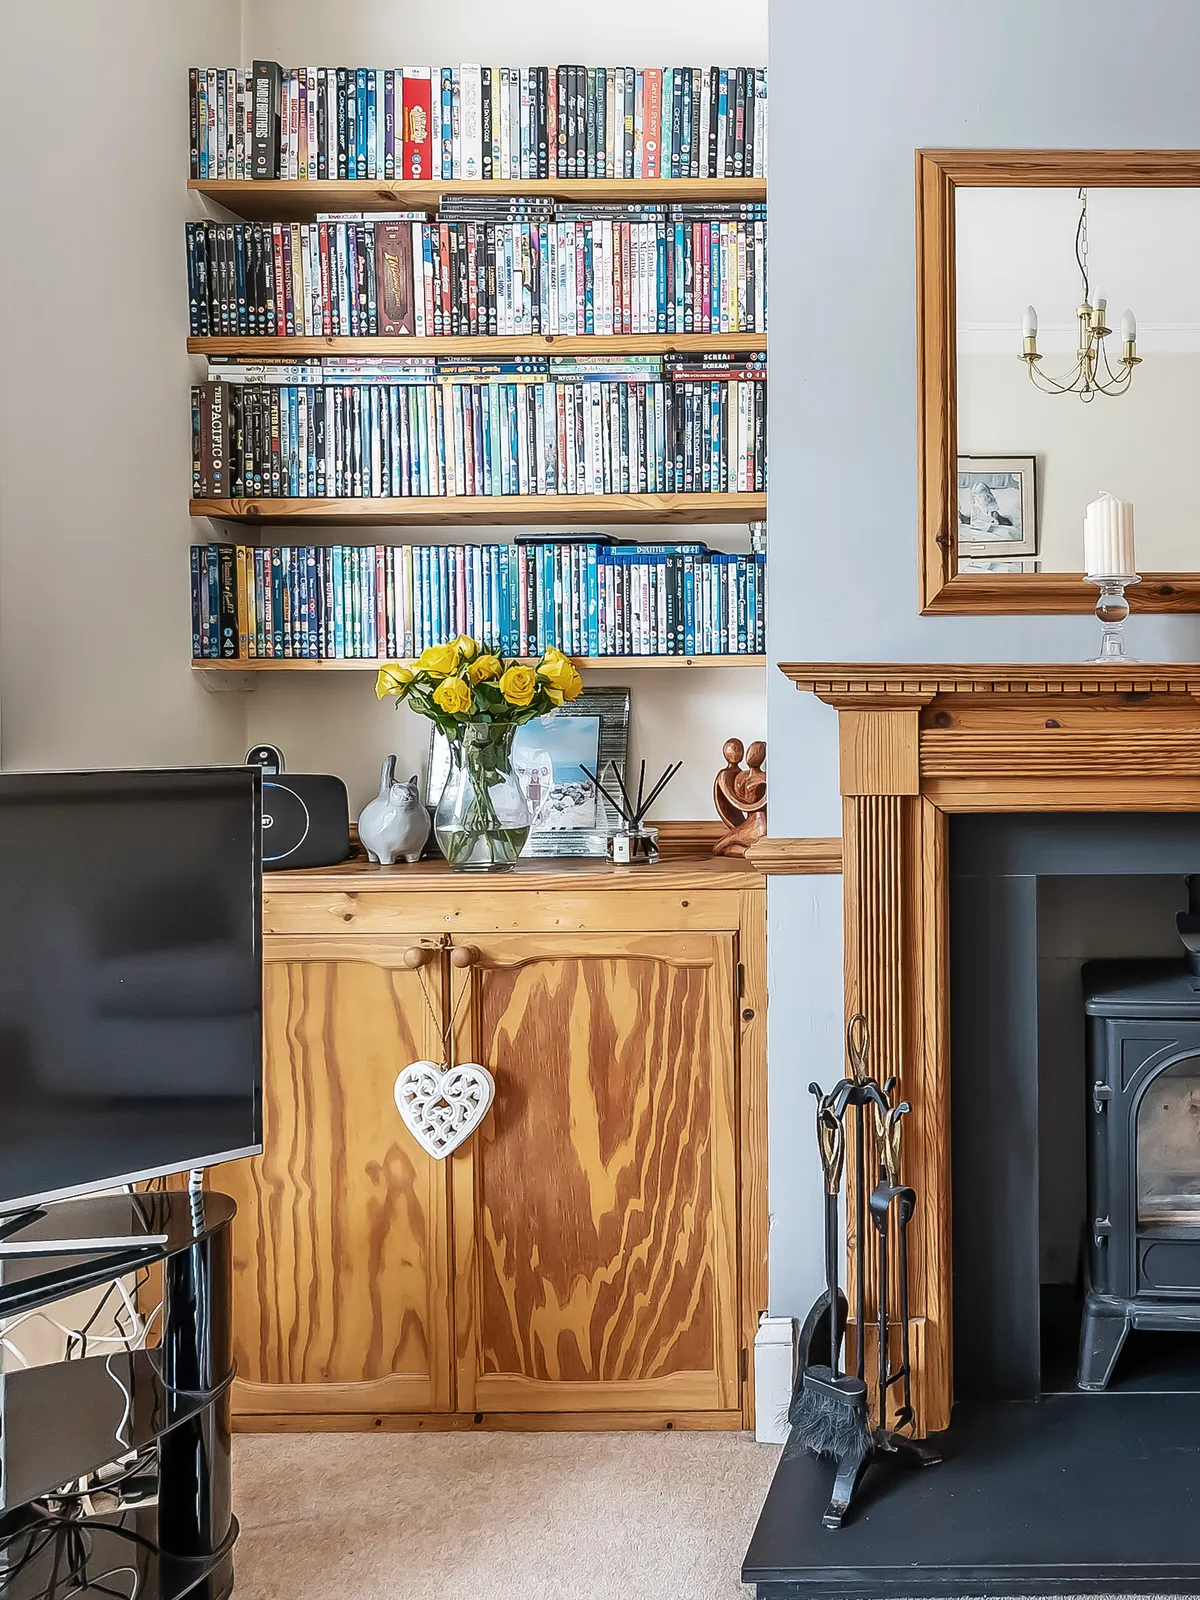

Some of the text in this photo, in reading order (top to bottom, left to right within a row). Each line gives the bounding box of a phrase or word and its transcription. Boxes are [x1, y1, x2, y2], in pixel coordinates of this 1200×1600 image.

[255, 78, 269, 97] BAND
[255, 103, 269, 138] BROTHERS
[625, 114, 633, 135] FURY
[649, 111, 658, 137] Stacey
[284, 280, 293, 299] POCUS
[211, 385, 223, 457] THE PACIFIC
